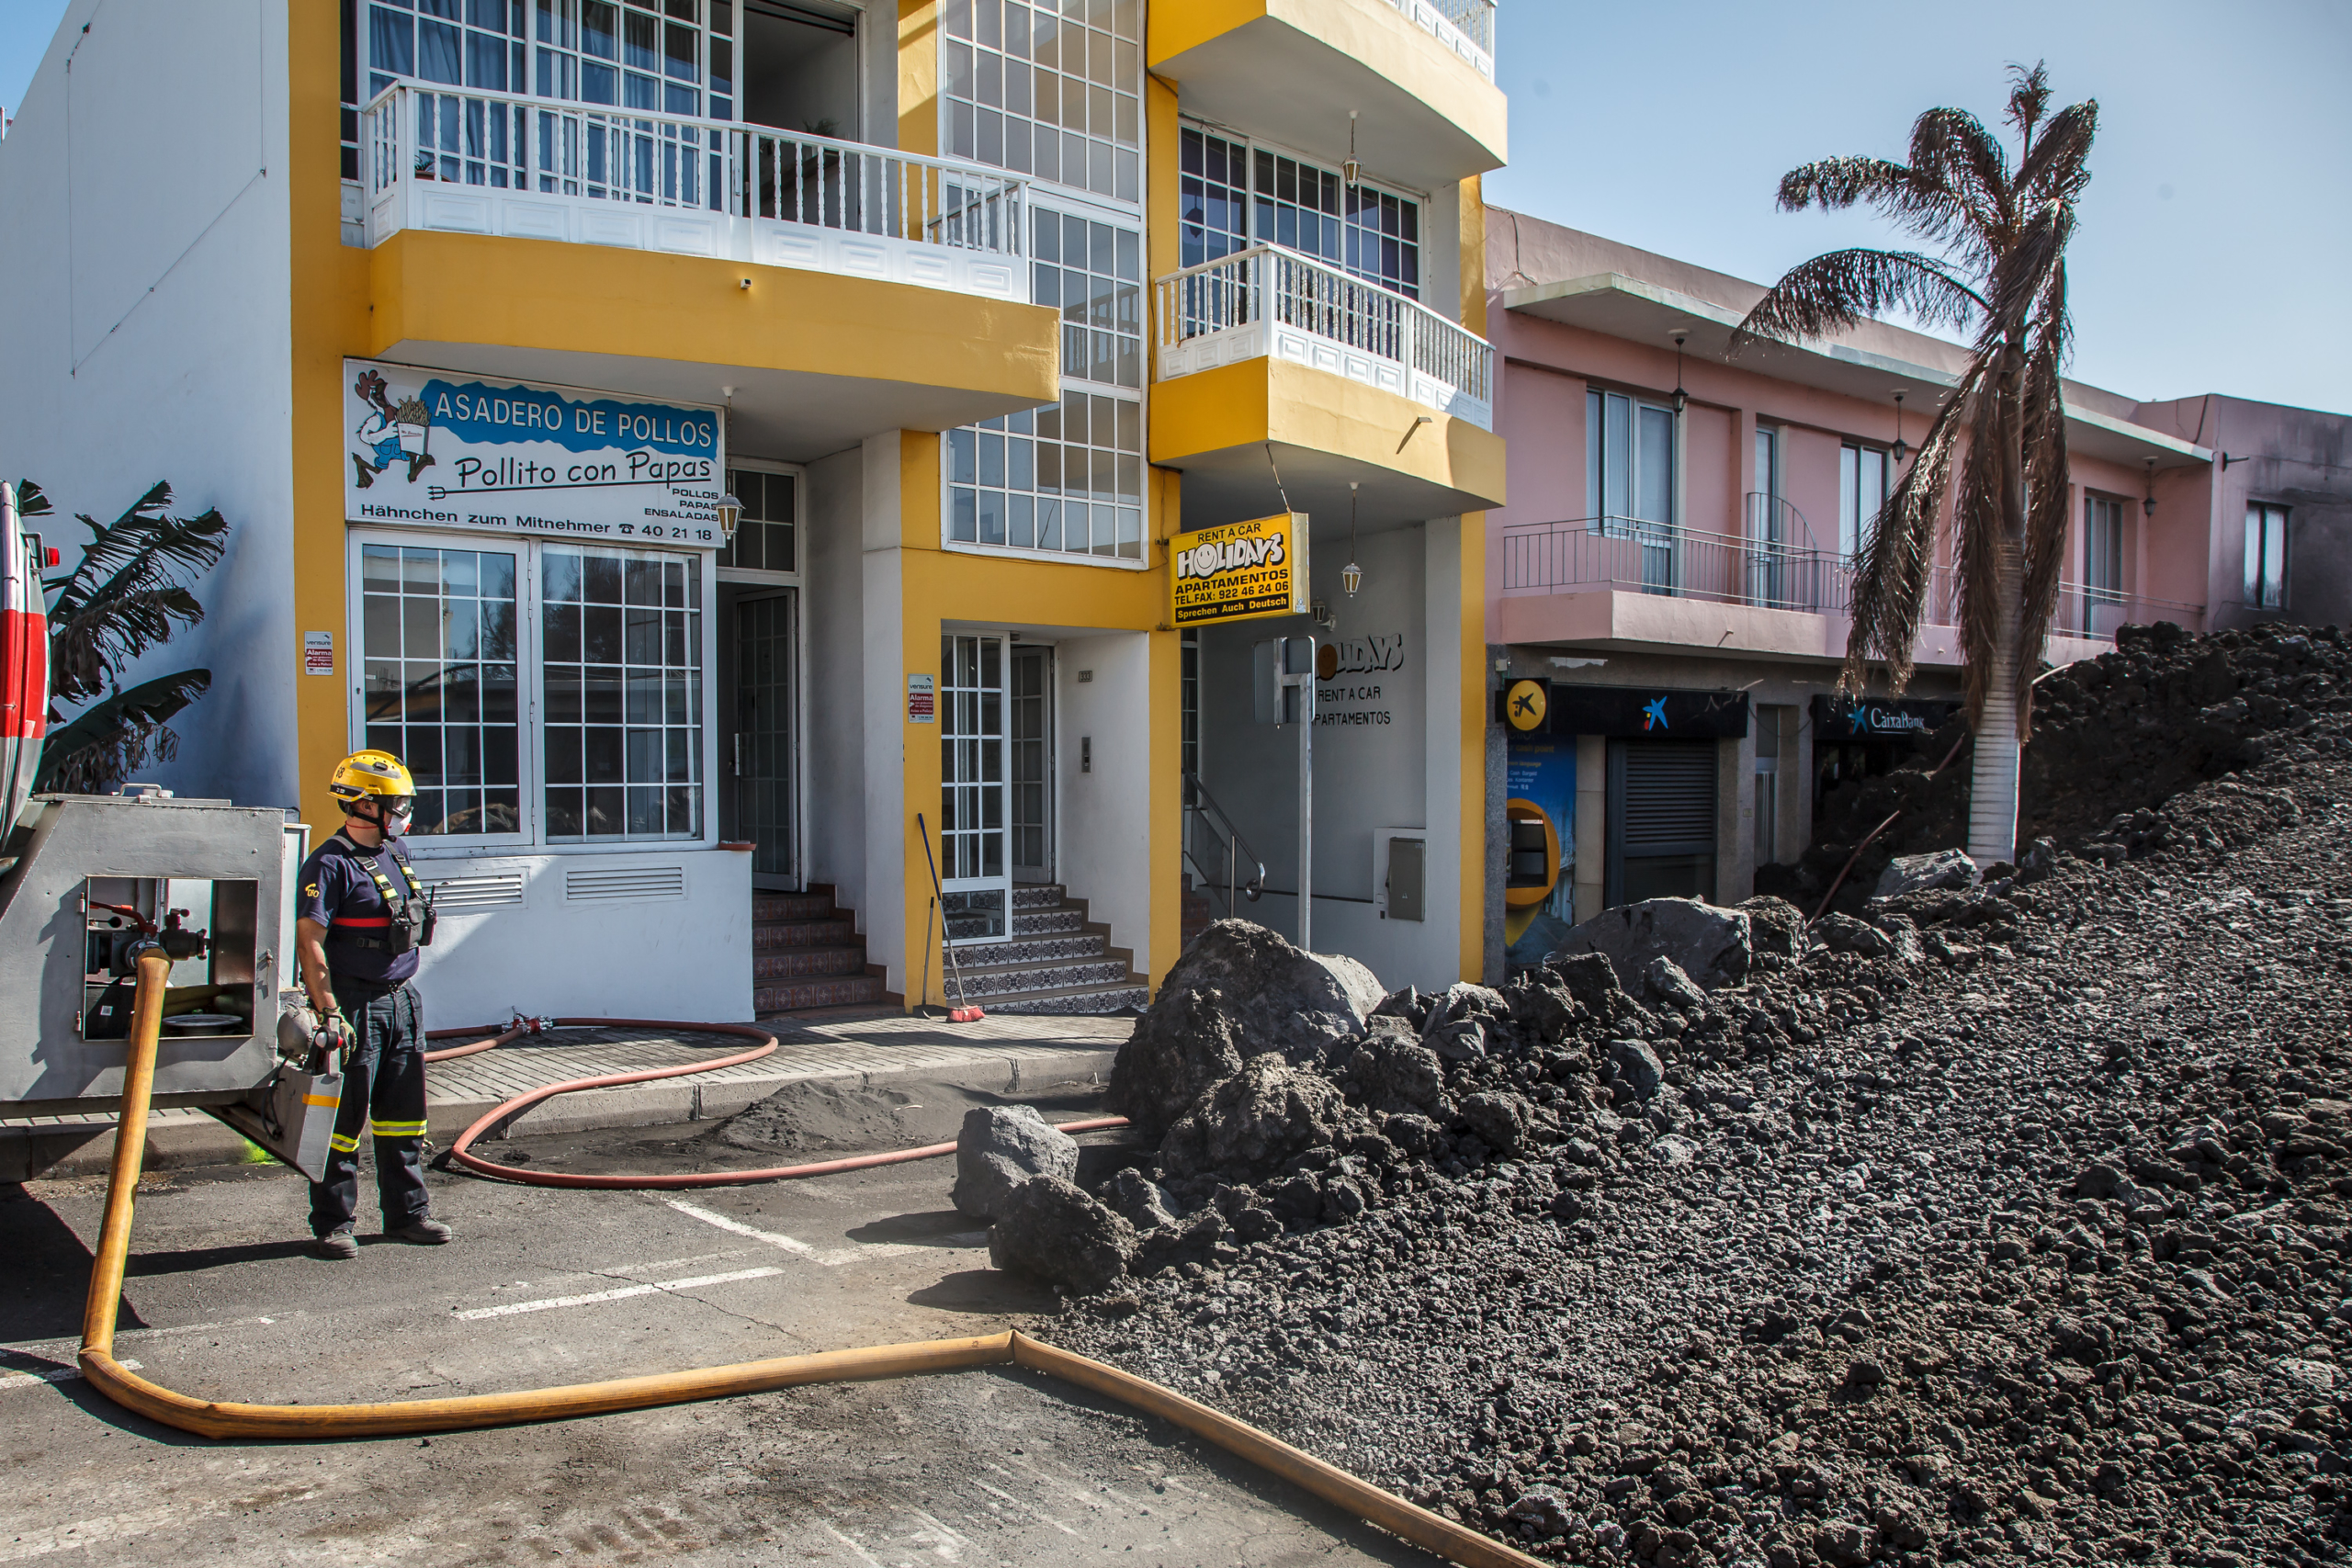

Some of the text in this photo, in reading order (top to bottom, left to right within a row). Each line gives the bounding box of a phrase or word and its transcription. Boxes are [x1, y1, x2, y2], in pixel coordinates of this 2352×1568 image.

[435, 392, 712, 448] ASADERO DE POLLOS
[455, 451, 710, 489] Pollito con Papas
[673, 488, 718, 500] POLLOS
[680, 500, 717, 511] PAPAS
[361, 504, 712, 540] Hähnchen zum Mitnehmer 40 21 18
[644, 508, 718, 522] ENSALADAS
[1198, 523, 1261, 543] RENT A CAR
[1177, 532, 1285, 581] HOLIDAYS
[1174, 581, 1289, 605] TEL.FAX: 922 46 24 06
[1175, 569, 1288, 595] APARTAMENTOS
[1177, 596, 1286, 620] Sprechen Auch Deutsch
[1315, 633, 1404, 682] OLIDAYS
[1317, 686, 1381, 703] RENT A CAR
[1871, 707, 1925, 729] CaixaBank
